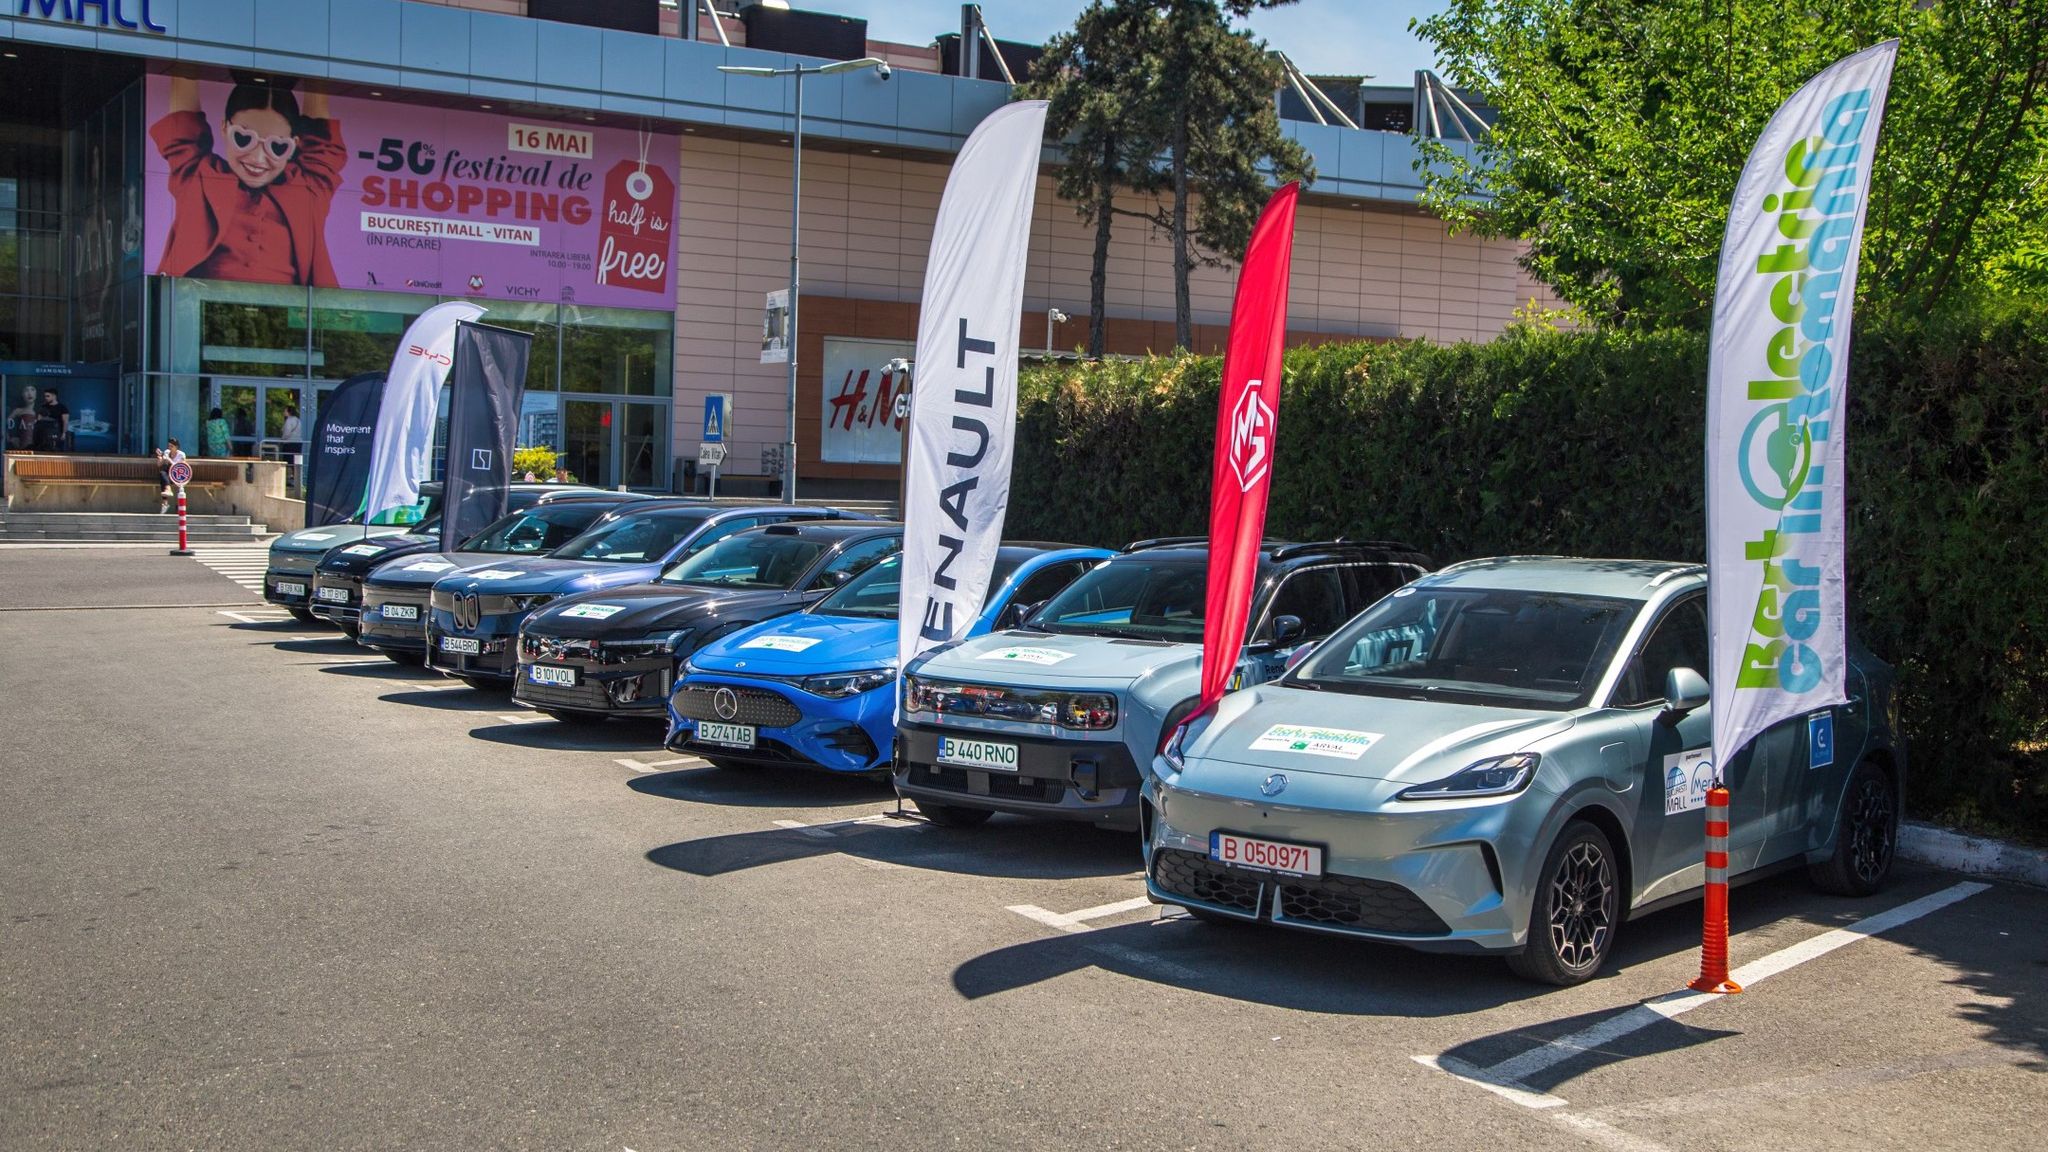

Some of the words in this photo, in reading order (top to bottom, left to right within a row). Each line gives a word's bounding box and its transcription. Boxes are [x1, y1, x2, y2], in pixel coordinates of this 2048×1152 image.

[515, 129, 540, 148] 16
[545, 131, 587, 154] MAI
[358, 138, 436, 175] -50%
[440, 149, 549, 194] festival
[558, 162, 593, 192] de
[360, 175, 592, 225] SHOPPING
[609, 200, 646, 235] half
[651, 210, 668, 231] is
[446, 223, 483, 238] MALL
[494, 227, 533, 242] VITAN
[385, 236, 442, 250] PARCARE)
[529, 249, 565, 260] INTRAREA
[548, 259, 566, 268] 10.00
[596, 236, 666, 285] free
[1786, 88, 1872, 442] Romania
[413, 279, 442, 290] UniCredit
[506, 285, 541, 297] VICHY
[408, 344, 451, 366] BYD
[829, 368, 905, 432] H&M
[326, 423, 372, 435] Movement
[326, 434, 344, 444] that
[920, 317, 997, 643] ENAULT
[384, 605, 389, 616] B
[391, 606, 399, 617] 04
[400, 607, 415, 618] ZKR
[1736, 529, 1797, 690] Best
[1778, 559, 1824, 694] car
[444, 638, 450, 649] B
[536, 667, 542, 679] B
[543, 668, 554, 681] 101
[555, 669, 572, 683] VOL
[701, 723, 708, 738] B
[945, 740, 955, 757] B
[958, 742, 982, 760] 440
[985, 744, 1015, 764] RNO
[1666, 796, 1688, 813] MALL
[1224, 837, 1238, 860] B
[1244, 841, 1309, 871] 050971
